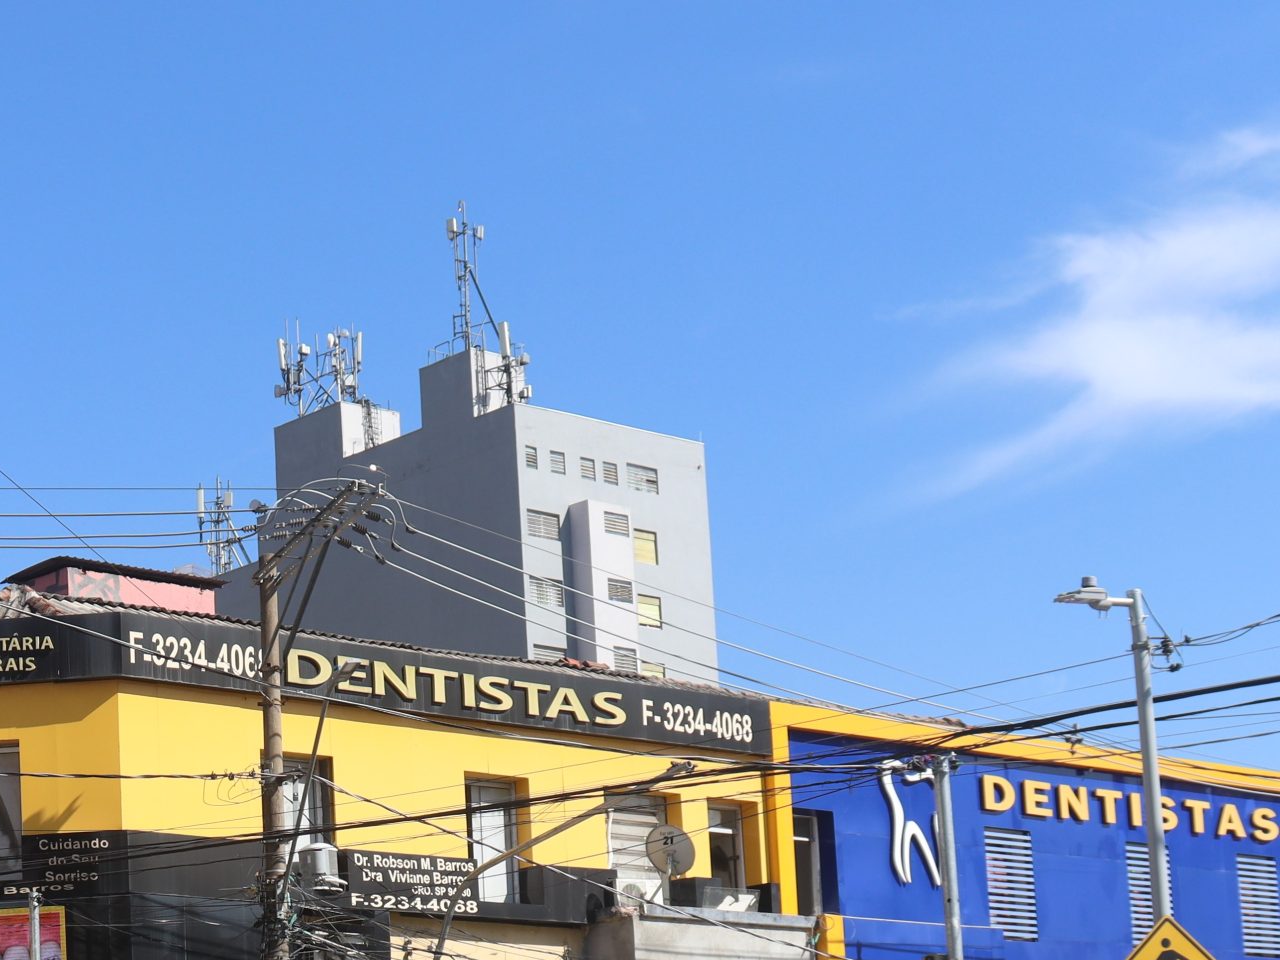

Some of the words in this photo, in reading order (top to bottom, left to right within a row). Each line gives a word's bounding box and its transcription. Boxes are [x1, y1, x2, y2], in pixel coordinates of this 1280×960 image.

[286, 647, 627, 726] DENTISTAS
[642, 698, 753, 743] F-3234-4068
[981, 774, 1279, 842] DENTISTAS
[39, 838, 109, 850] Cuidando
[663, 836, 674, 845] 21
[354, 853, 371, 867] Dr.
[373, 854, 417, 869] Robson
[421, 858, 434, 870] M.
[437, 859, 475, 872] Barros
[45, 870, 98, 882] Sorriso
[388, 870, 430, 884] Viviane
[433, 872, 468, 885] Barro
[4, 884, 74, 896] Barros
[435, 887, 446, 896] SP
